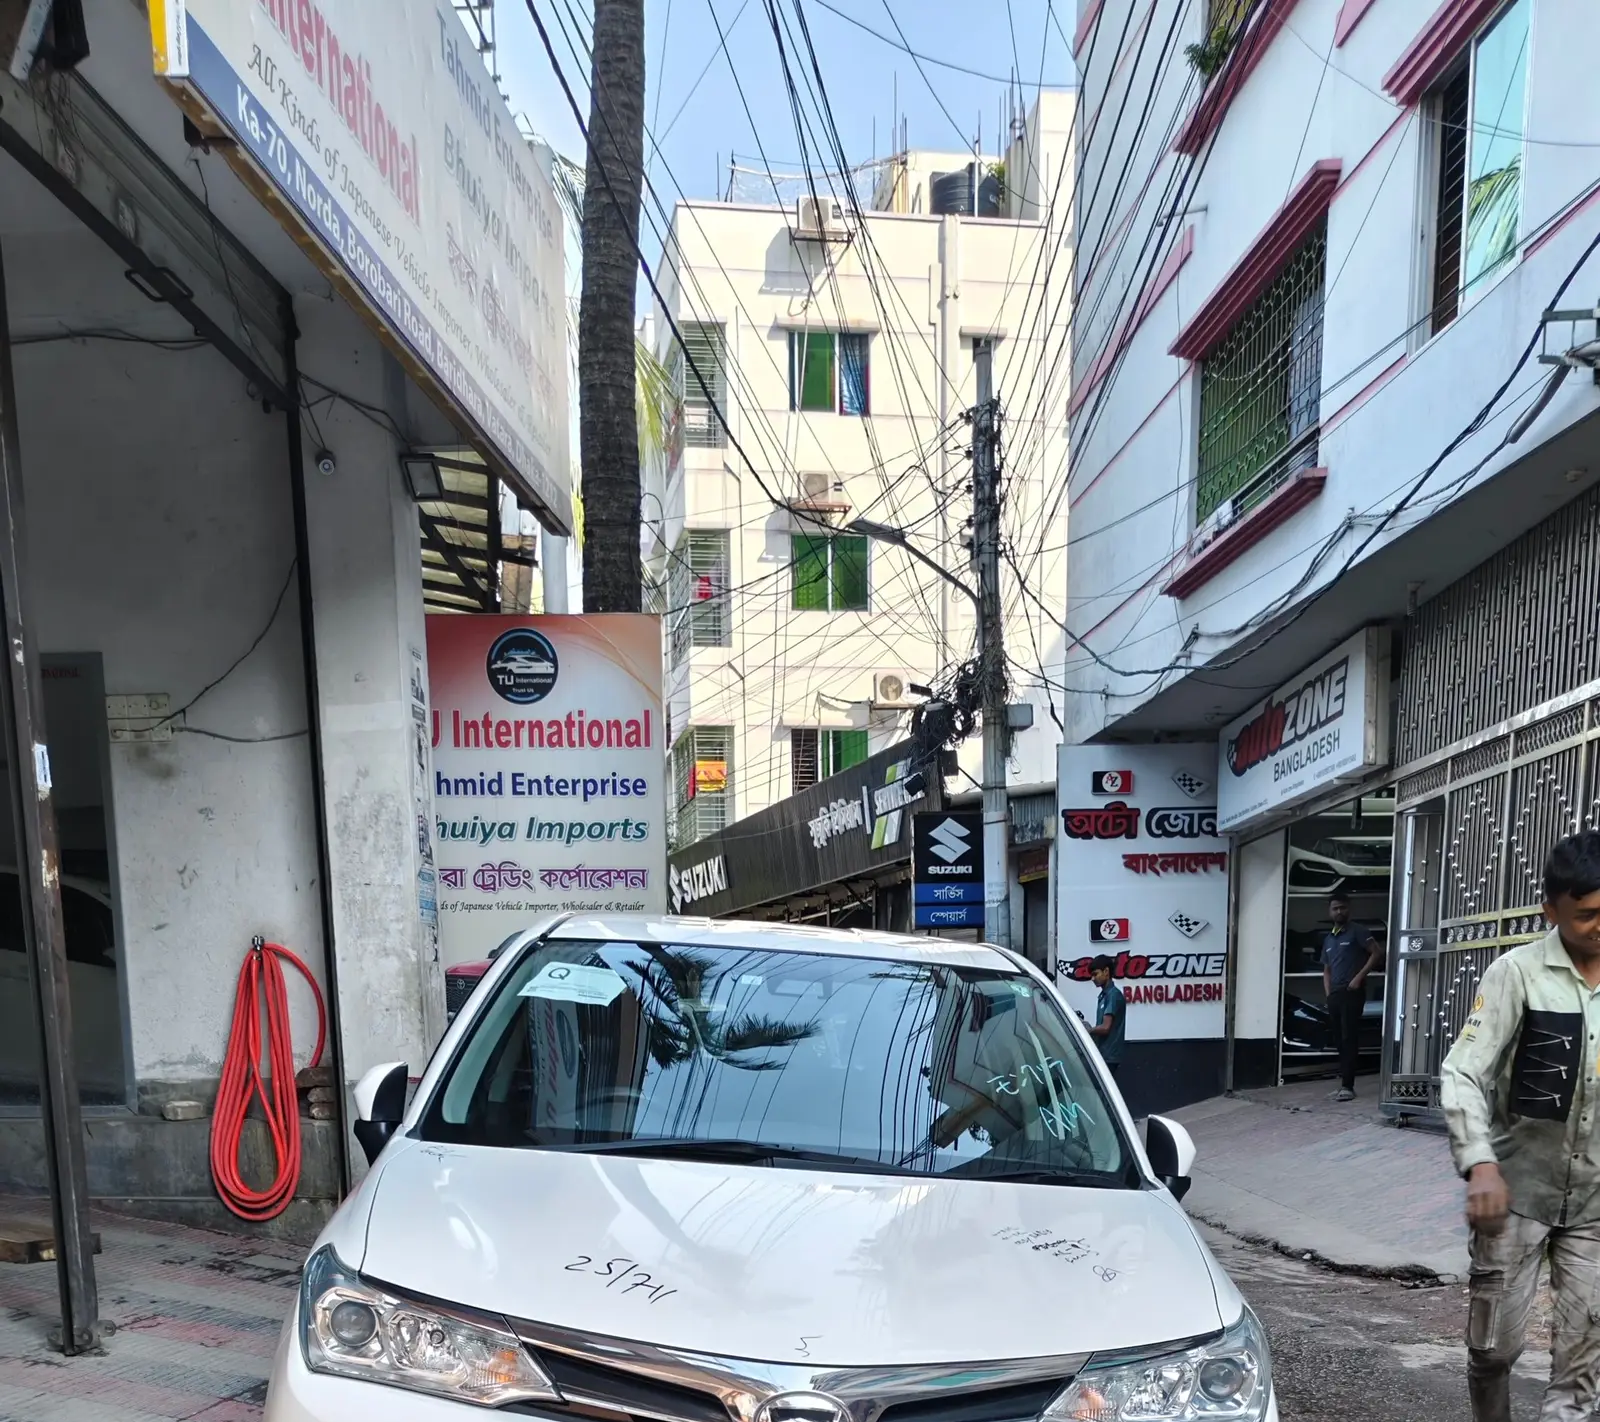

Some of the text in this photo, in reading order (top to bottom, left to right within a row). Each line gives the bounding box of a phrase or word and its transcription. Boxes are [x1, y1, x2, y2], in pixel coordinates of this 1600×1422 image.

[257, 0, 420, 224] ternational
[436, 6, 553, 247] Tahmid Enterprise
[247, 43, 277, 93] All
[279, 78, 321, 154] Kinds
[325, 150, 339, 181] of
[340, 164, 392, 248] Japanese
[394, 237, 430, 300] Vehicle
[237, 84, 293, 186] Ka-70,
[295, 158, 345, 252] Norda,
[347, 225, 402, 318] Borobari
[404, 305, 434, 358] Road,
[444, 121, 500, 242] Bhuiya
[505, 221, 556, 338] Imports
[497, 675, 514, 685] TU
[452, 709, 651, 748] International
[1273, 728, 1341, 782] BANGLADESH
[436, 771, 647, 802] hmid Enterprise
[436, 814, 648, 845] huiya Imports
[1062, 802, 1140, 839] অটো
[473, 861, 534, 892] ট্রেডিং
[539, 863, 648, 889] কর্পোরেশন
[681, 855, 726, 903] SUZUKI
[928, 865, 973, 875] SUZUKI
[1122, 852, 1227, 877] বাংলাদেশ
[450, 900, 459, 913] of
[460, 902, 493, 913] Japanese
[494, 901, 522, 911] Vehicle
[524, 902, 559, 913] Importer,
[560, 901, 603, 911] Wholesaler
[604, 901, 614, 911] &
[615, 901, 645, 912] Retailer
[933, 885, 964, 900] সার্ভিস
[548, 967, 571, 980] Q
[1072, 950, 1227, 982] atoZONE
[1122, 983, 1223, 1004] BANGLADESH
